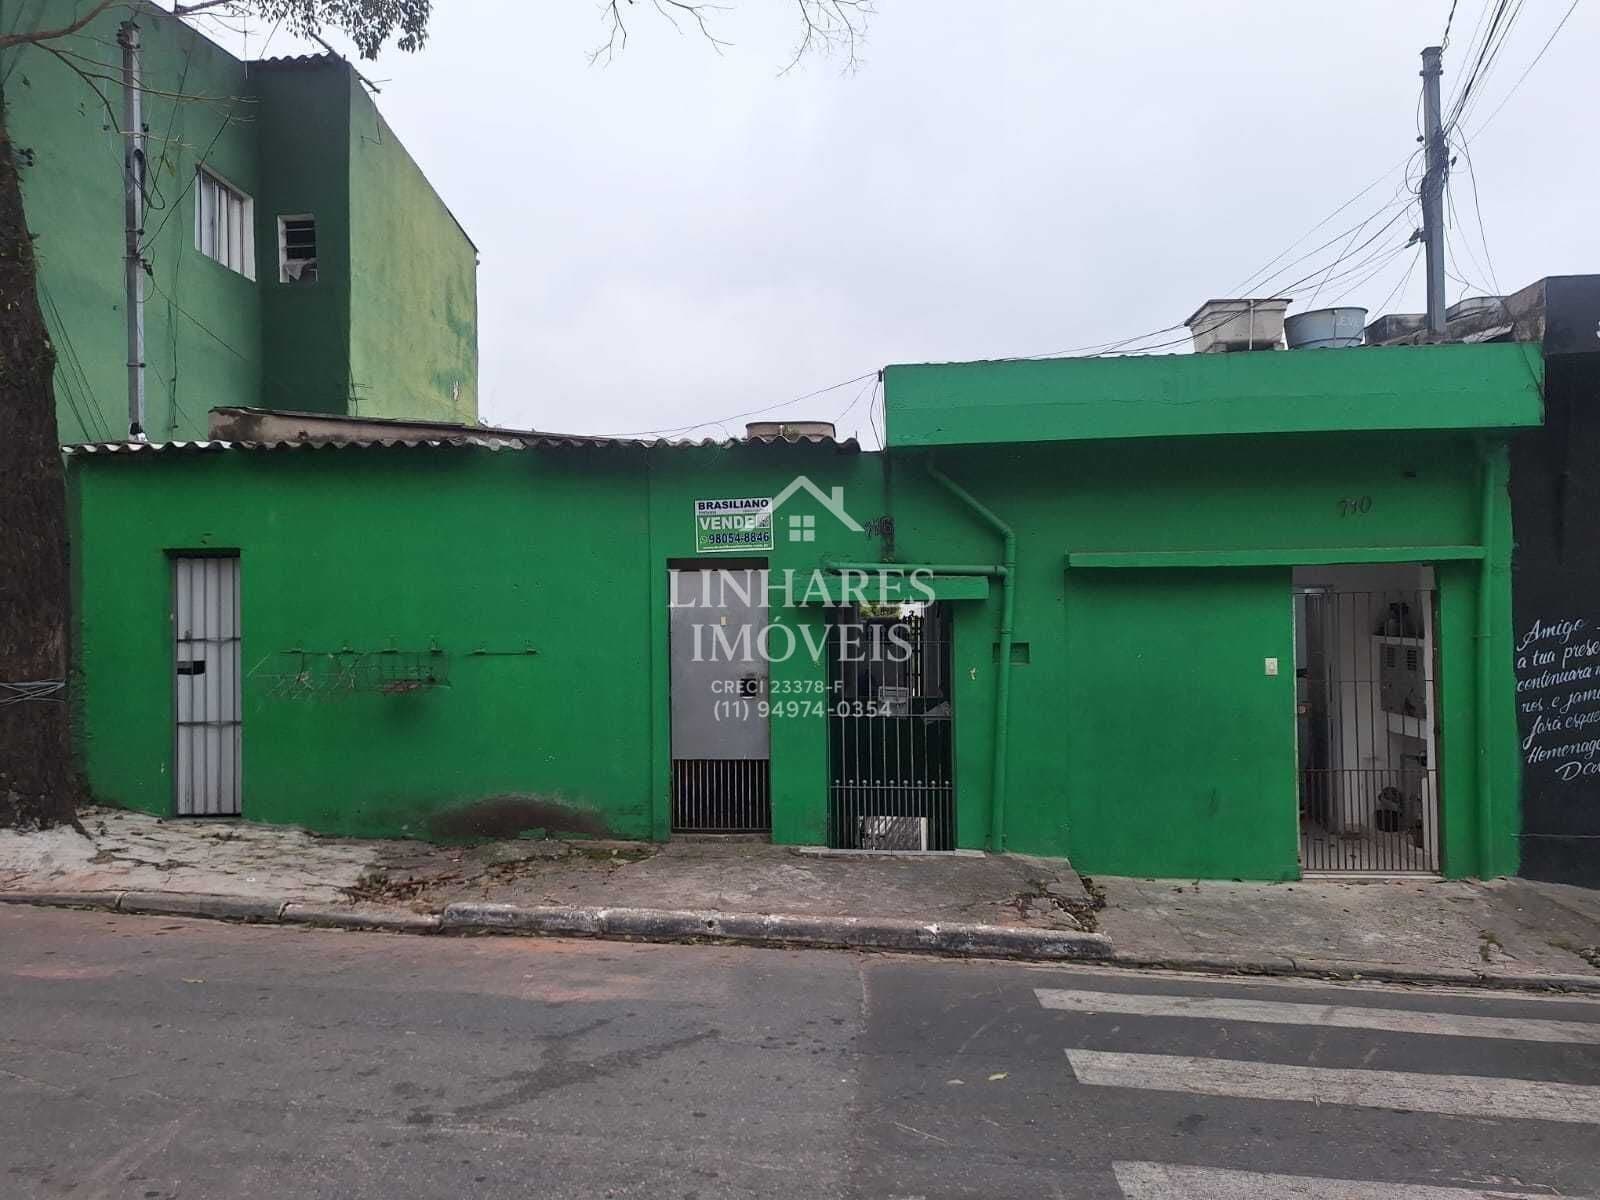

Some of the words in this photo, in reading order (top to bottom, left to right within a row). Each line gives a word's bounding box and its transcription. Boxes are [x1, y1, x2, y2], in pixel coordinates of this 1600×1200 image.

[698, 499, 769, 511] BRASILIANO
[708, 531, 769, 544] 98054-8846
[1517, 656, 1527, 669] a
[1533, 650, 1556, 667] tua
